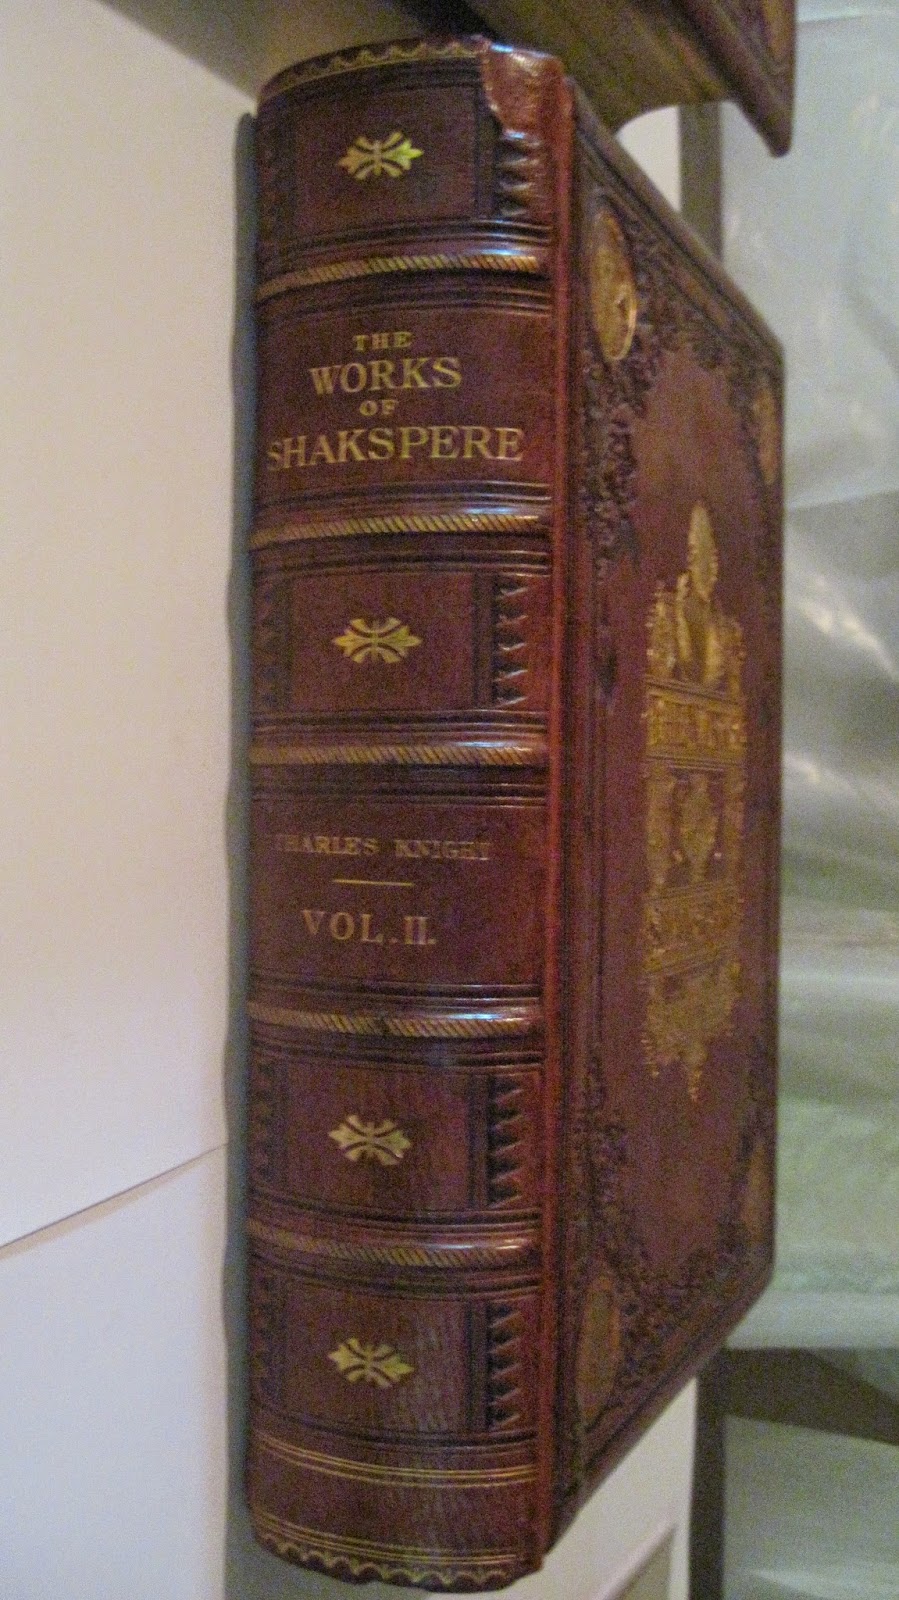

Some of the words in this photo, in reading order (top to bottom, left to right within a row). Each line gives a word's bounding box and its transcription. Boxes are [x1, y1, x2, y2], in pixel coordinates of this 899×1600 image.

[353, 331, 413, 350] THE
[309, 357, 462, 396] WORKS
[359, 399, 399, 416] OF
[267, 425, 525, 471] SHAKSPERE
